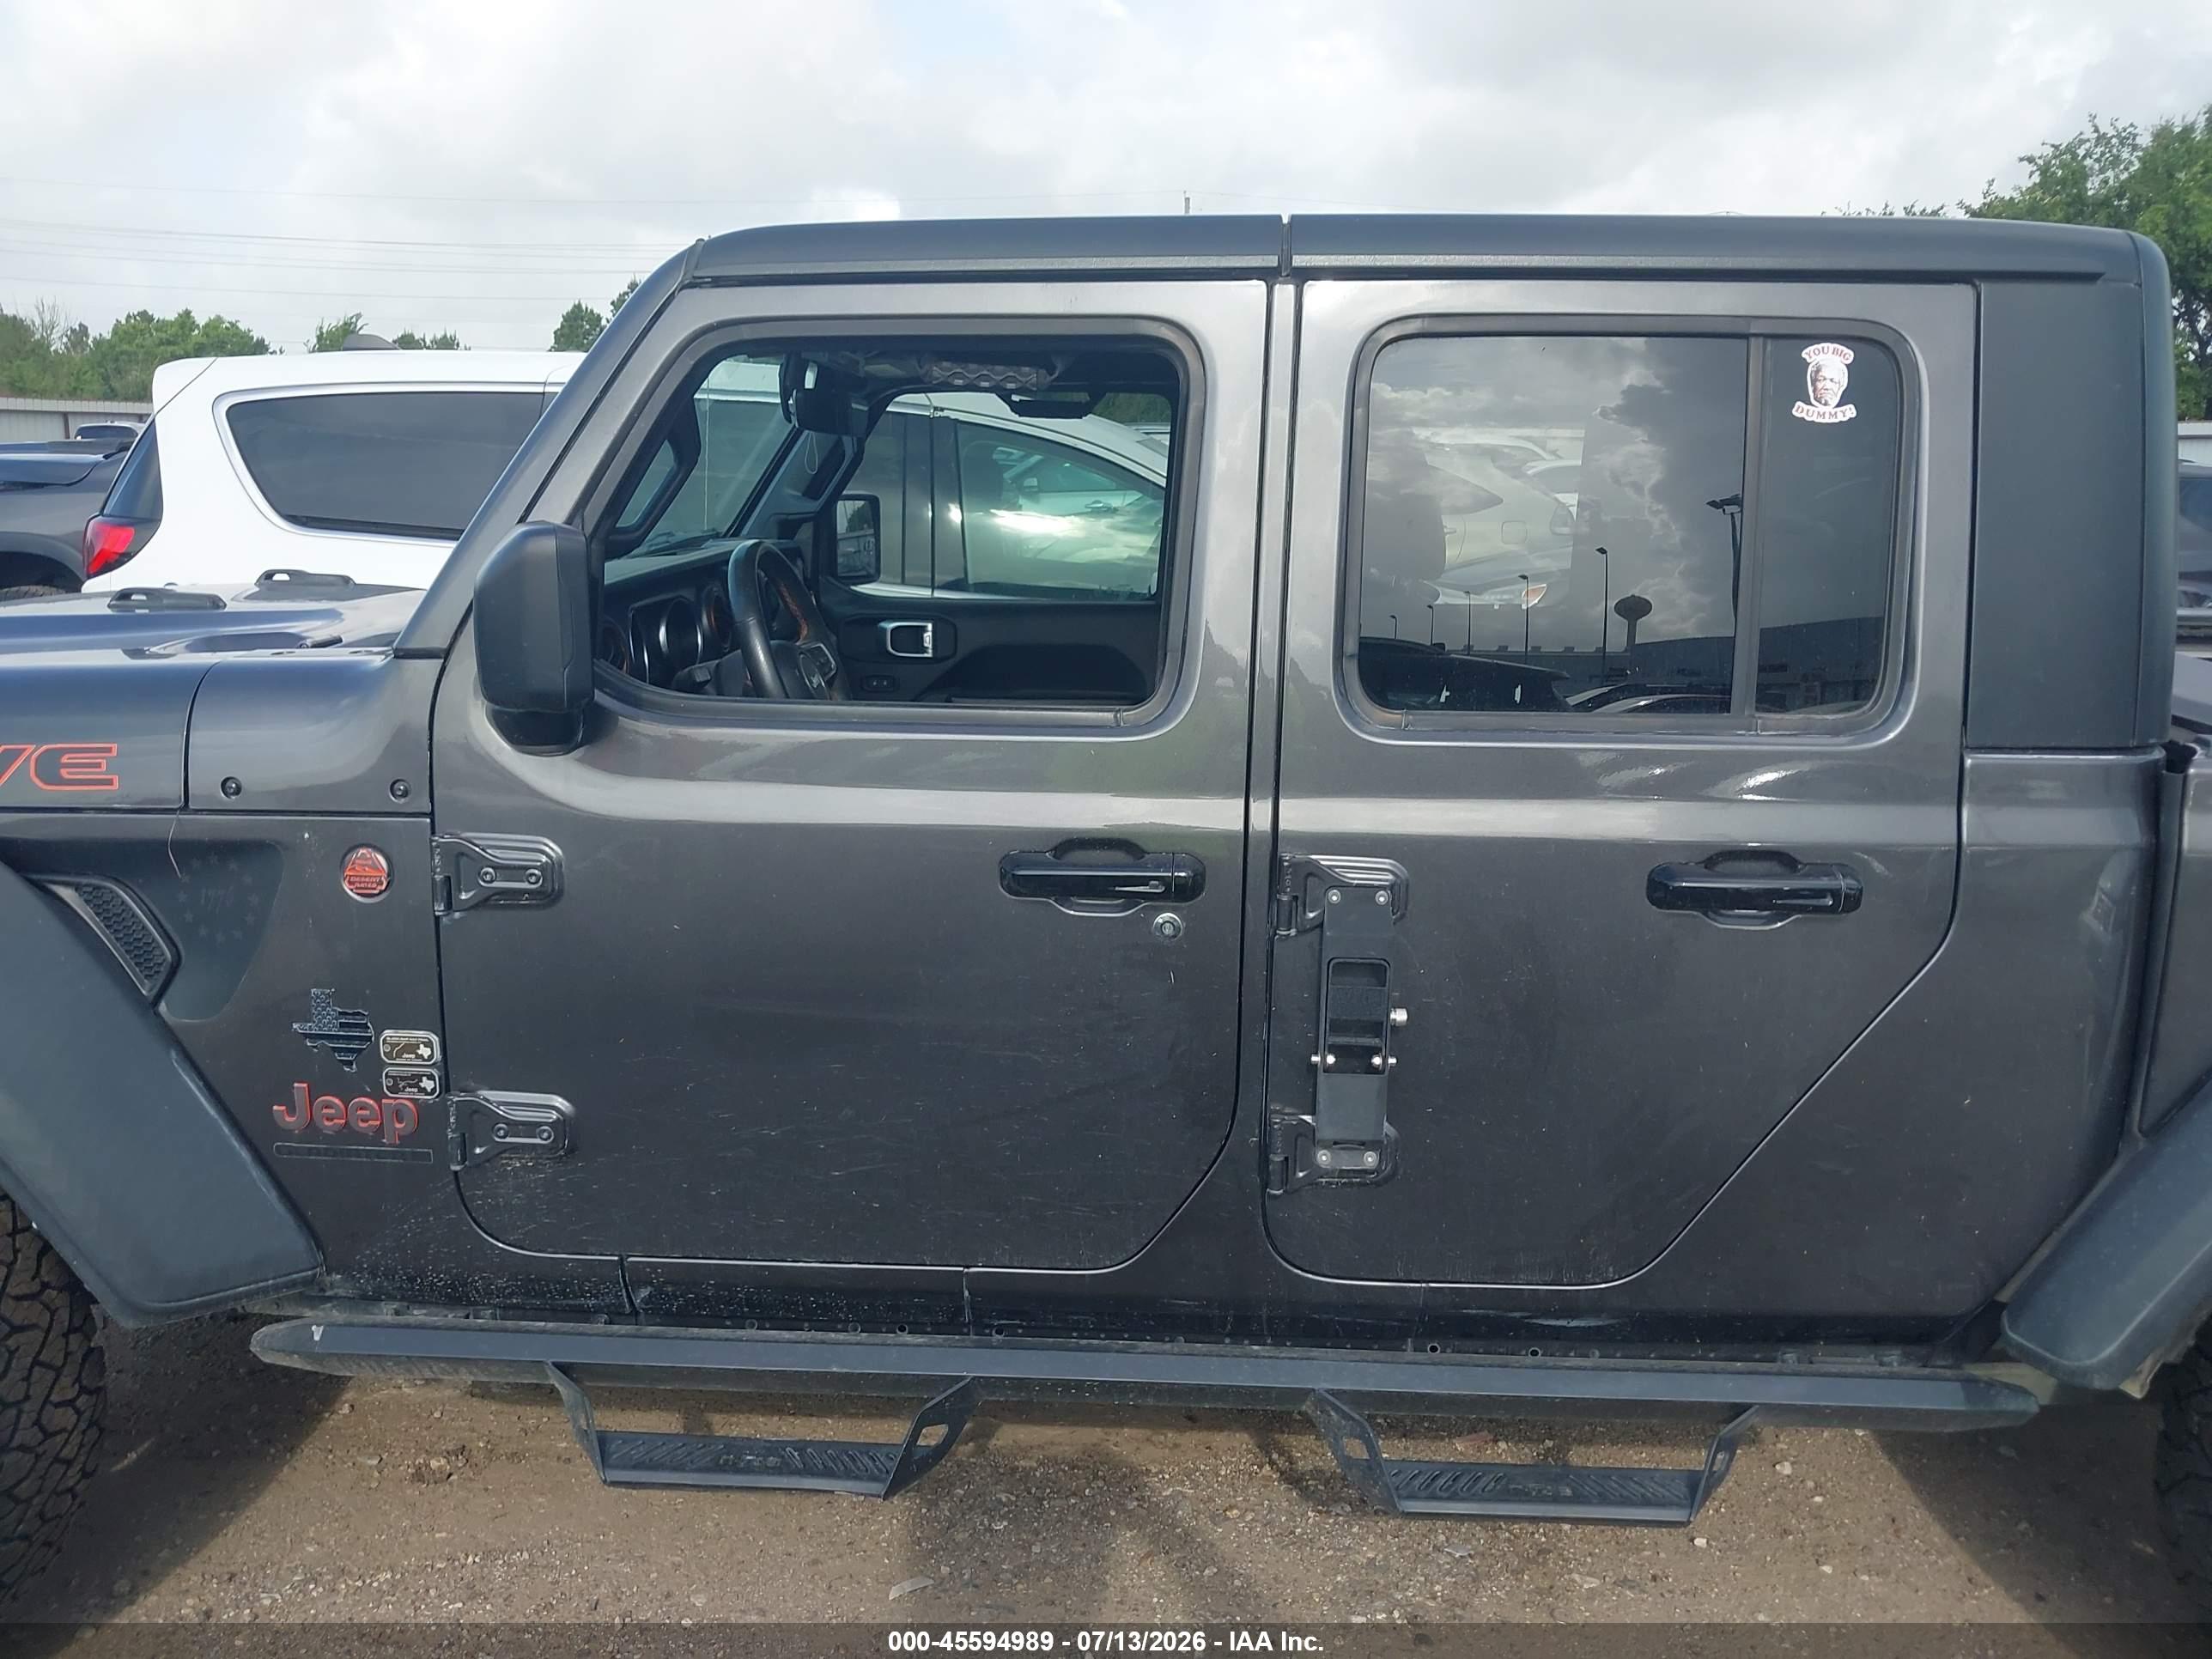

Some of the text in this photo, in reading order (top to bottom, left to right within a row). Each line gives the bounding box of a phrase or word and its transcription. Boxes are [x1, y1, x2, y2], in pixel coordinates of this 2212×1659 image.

[1804, 345, 1852, 362] YOU BIG
[1795, 405, 1854, 420] DUMMY!
[272, 1082, 419, 1145] Jeep
